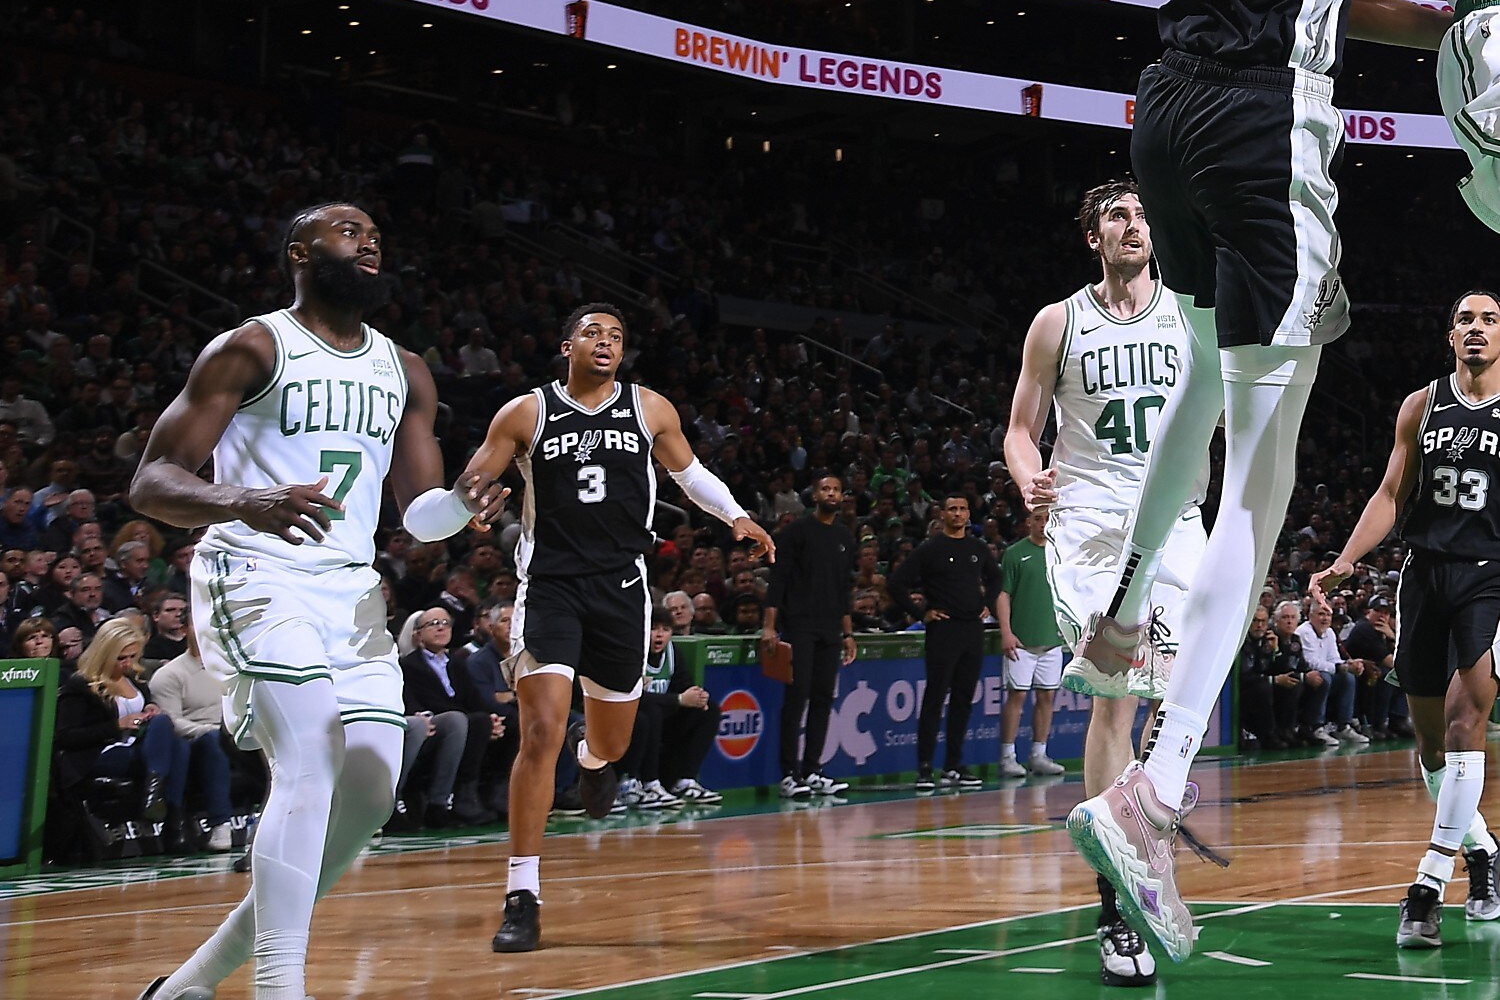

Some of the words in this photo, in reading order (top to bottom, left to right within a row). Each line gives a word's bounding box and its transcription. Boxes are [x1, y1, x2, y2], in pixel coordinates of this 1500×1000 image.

[674, 27, 789, 78] BREWIN'
[799, 54, 942, 99] LEGENDS
[1156, 315, 1177, 323] VISTA
[1081, 342, 1178, 395] CELTICS
[280, 379, 400, 445] CELTICS
[611, 408, 633, 418] Self.
[1095, 395, 1166, 455] 40
[543, 429, 639, 463] SPURS
[319, 450, 362, 520] 7
[577, 464, 607, 503] 3
[1432, 465, 1490, 512] 33
[1, 667, 40, 683] xfinity
[719, 713, 761, 736] Gulf
